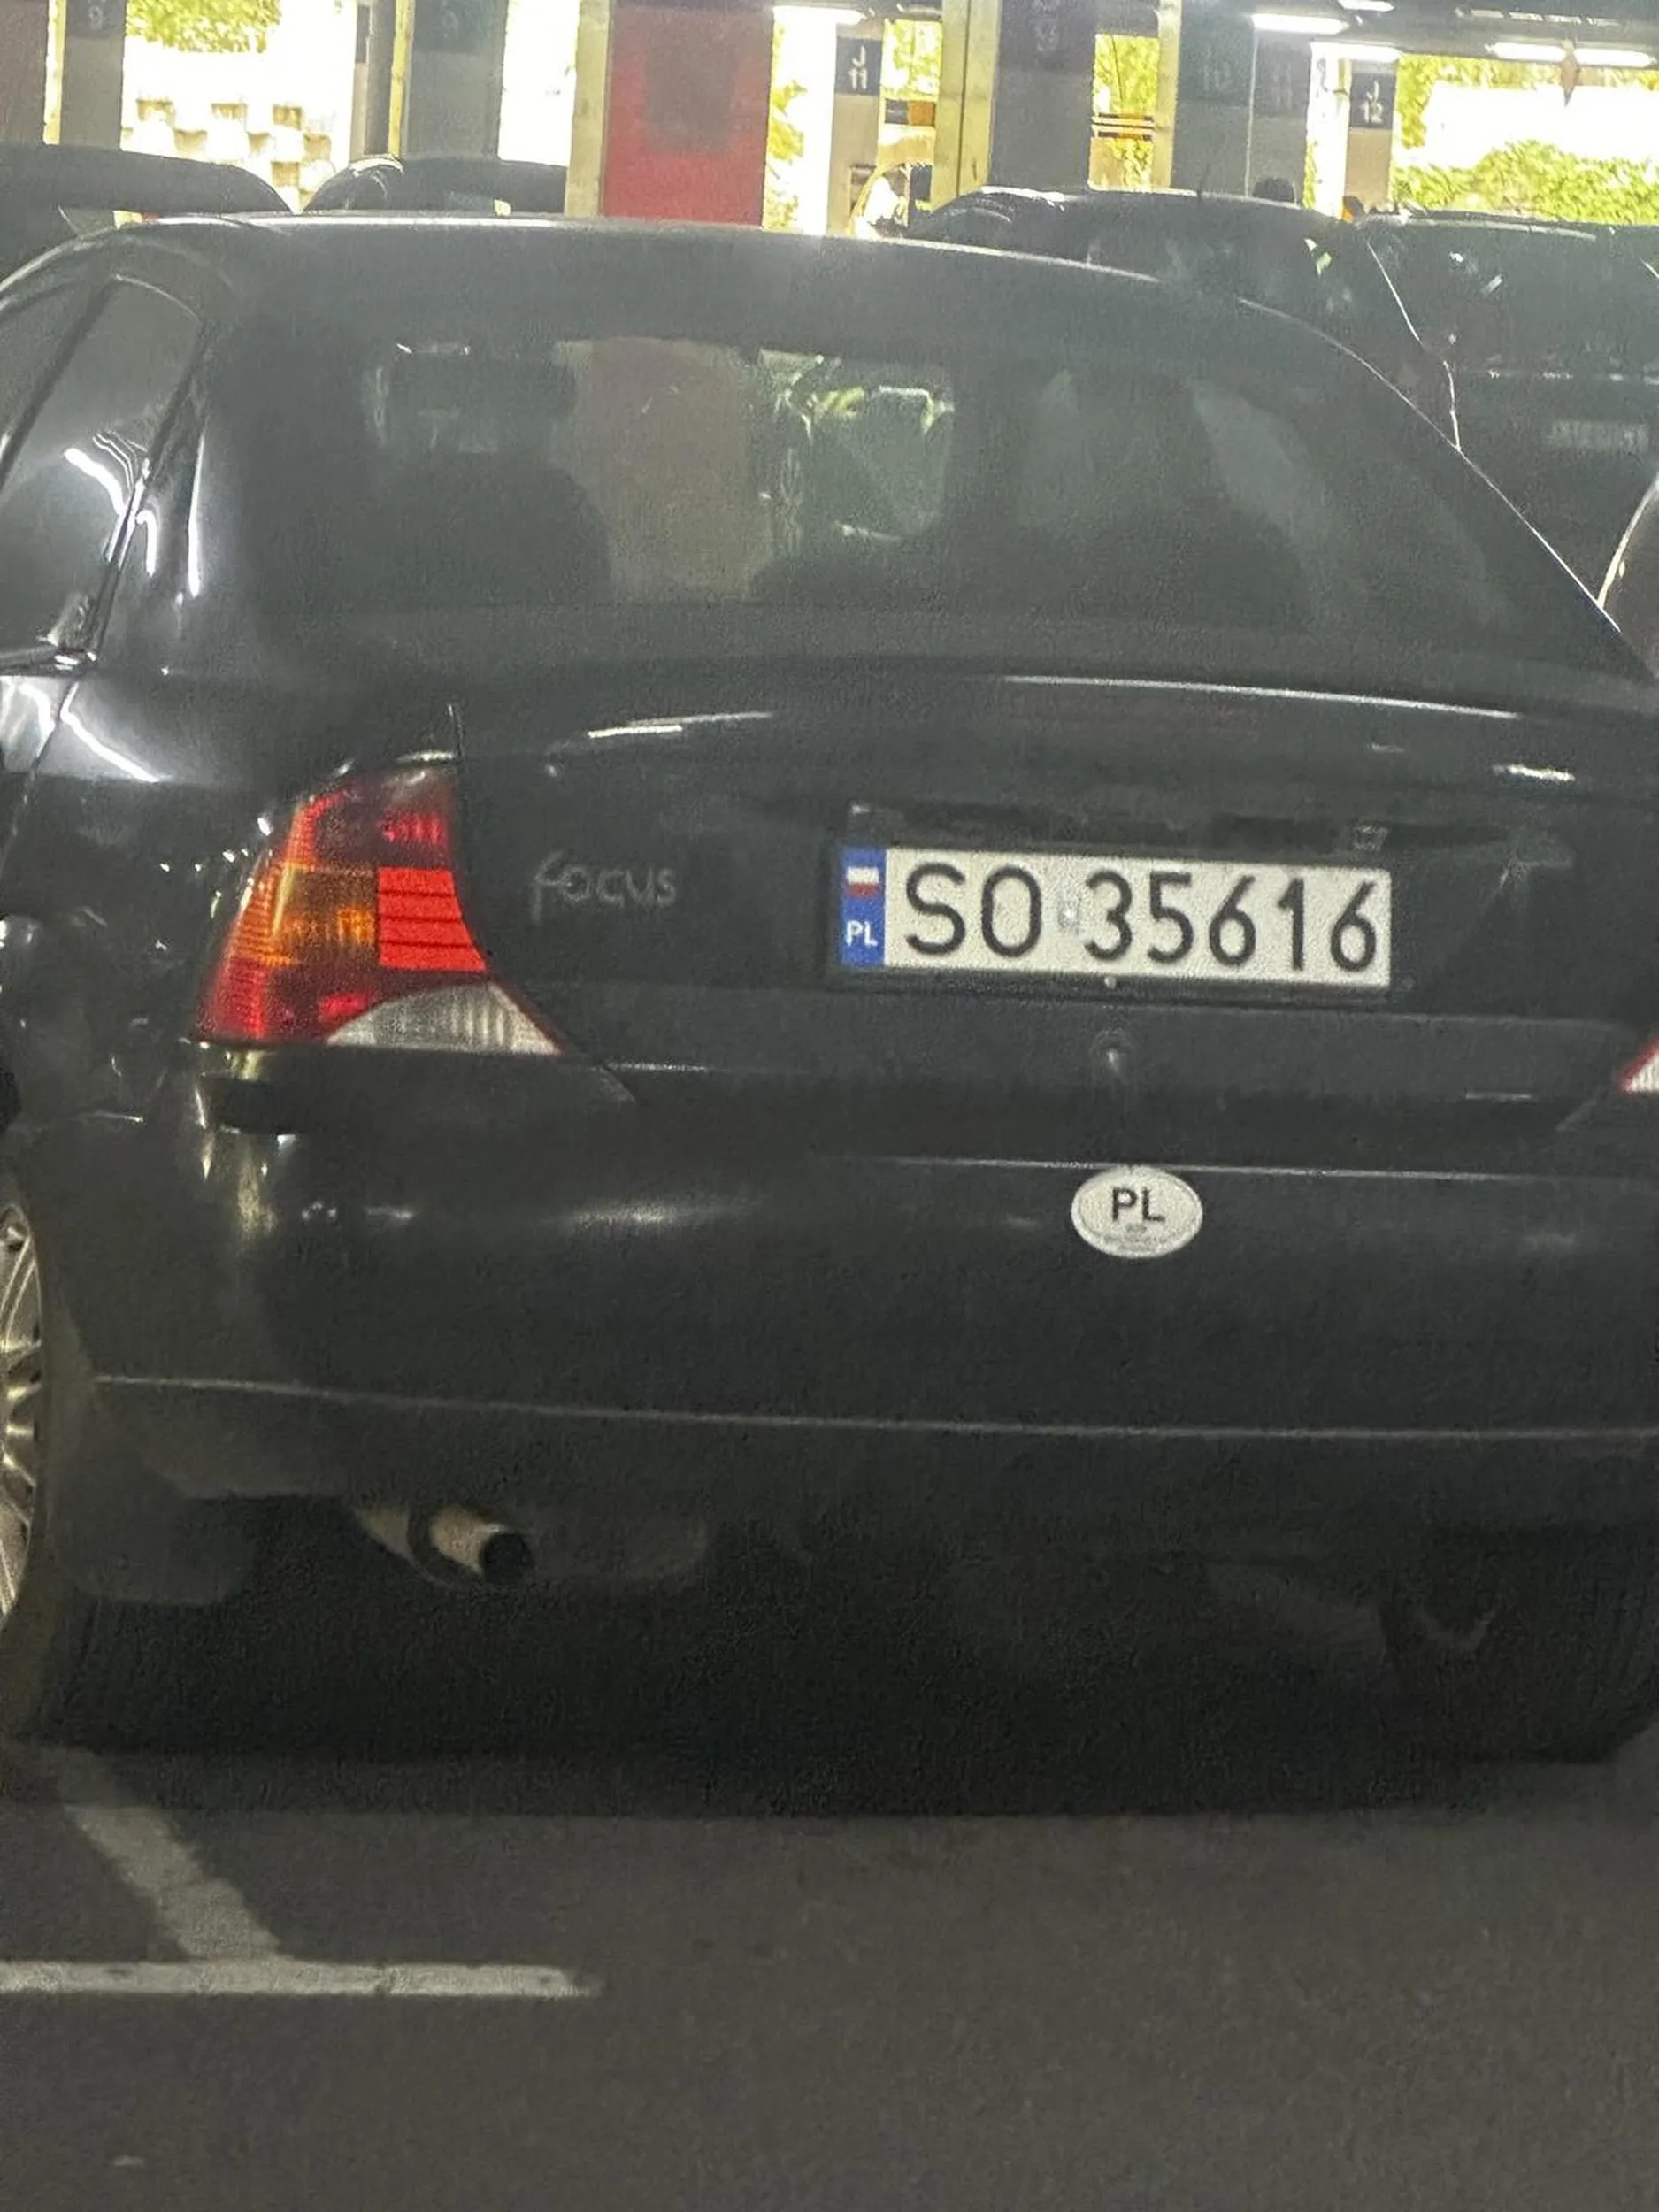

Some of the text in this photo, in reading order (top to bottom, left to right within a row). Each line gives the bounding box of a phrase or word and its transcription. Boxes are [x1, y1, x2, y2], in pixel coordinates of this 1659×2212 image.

[852, 45, 866, 67] J
[906, 862, 1378, 972] SO 35616
[846, 919, 879, 947] PL
[1111, 1187, 1166, 1222] PL
